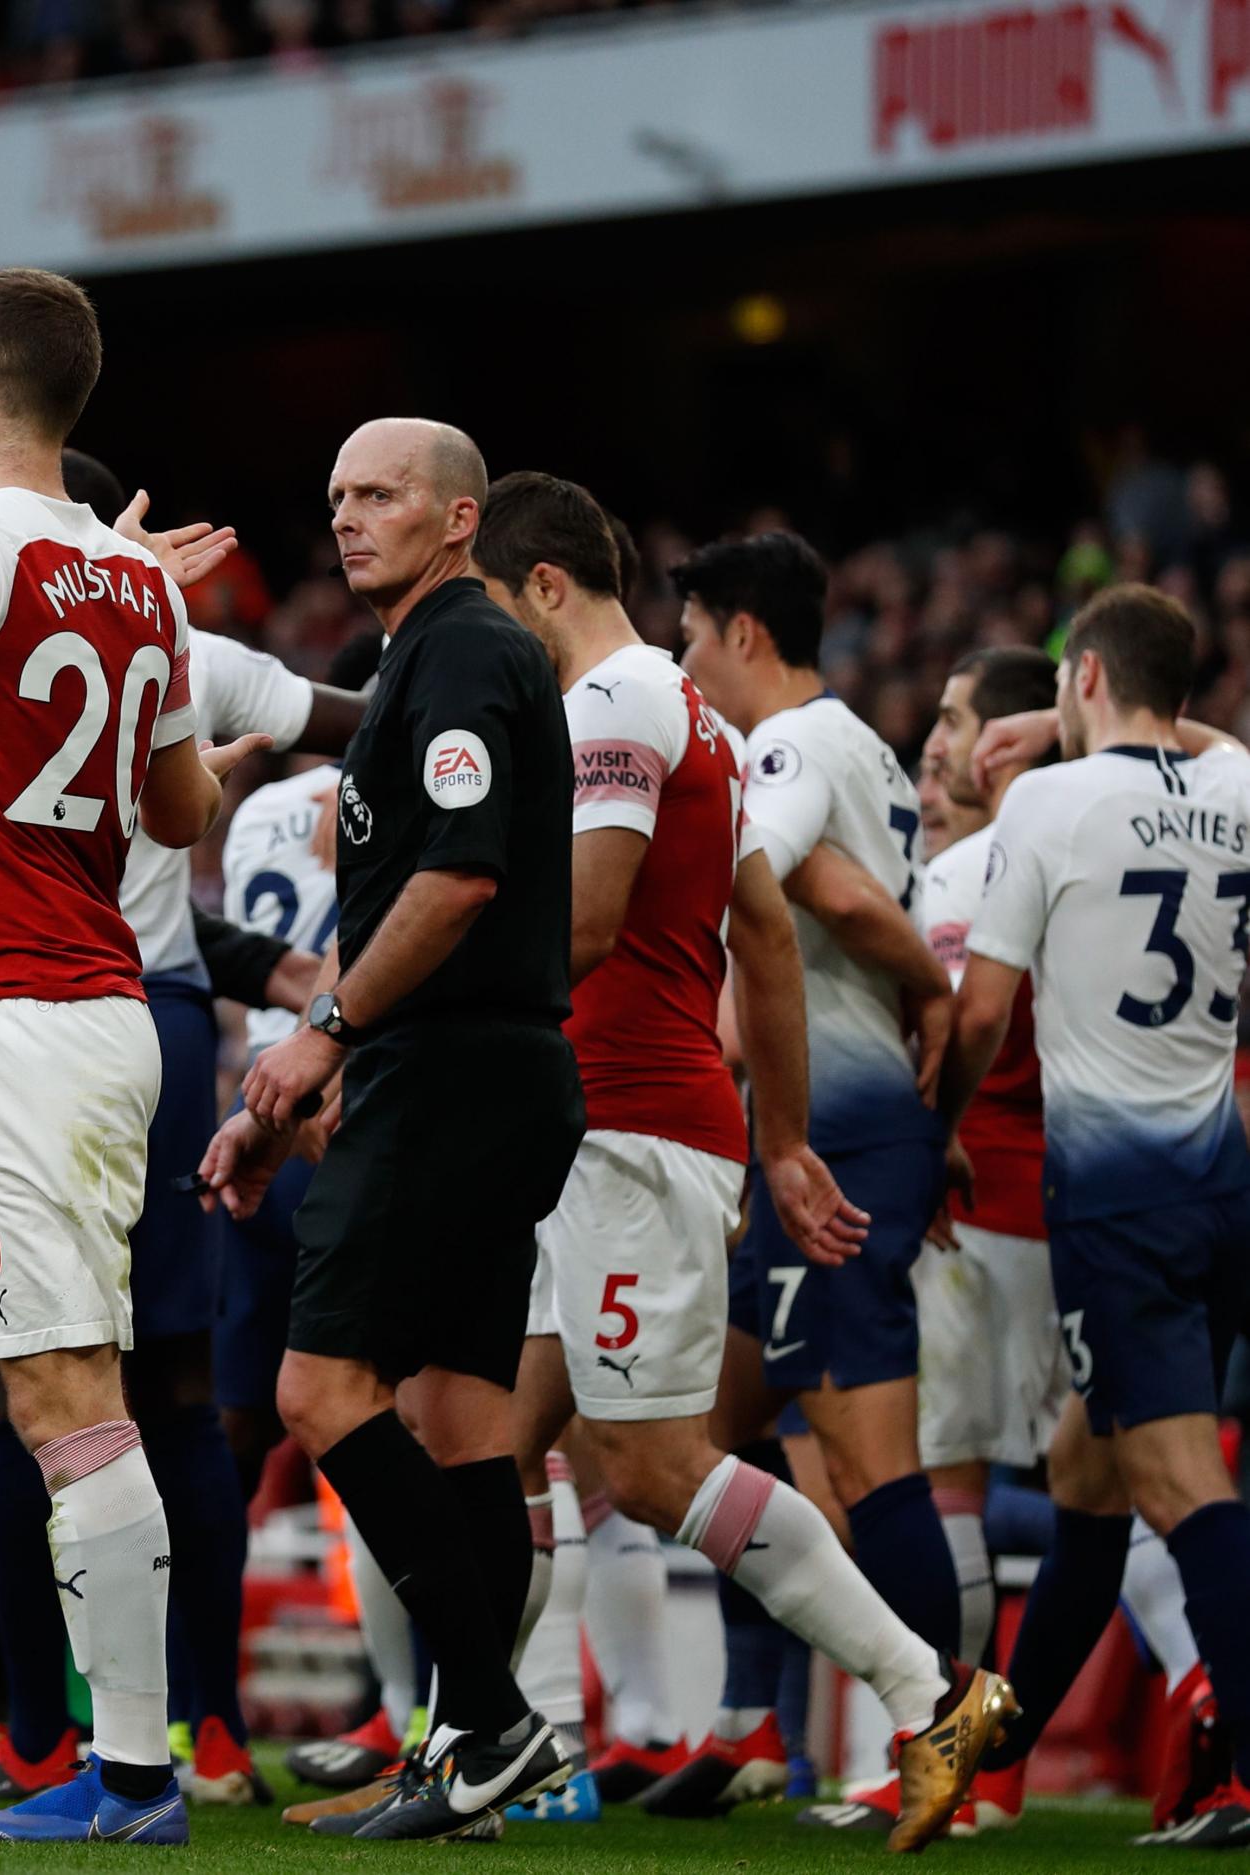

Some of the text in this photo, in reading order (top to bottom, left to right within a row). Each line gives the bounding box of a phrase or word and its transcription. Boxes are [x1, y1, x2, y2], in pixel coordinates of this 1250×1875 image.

[41, 560, 161, 633] MUSTAFI
[2, 630, 172, 840] 20
[433, 747, 480, 779] EA
[581, 751, 633, 768] VISIT
[434, 773, 483, 792] SPORTS
[1131, 808, 1248, 854] DAVIES
[594, 1273, 640, 1350] 5
[766, 1266, 808, 1341] 7
